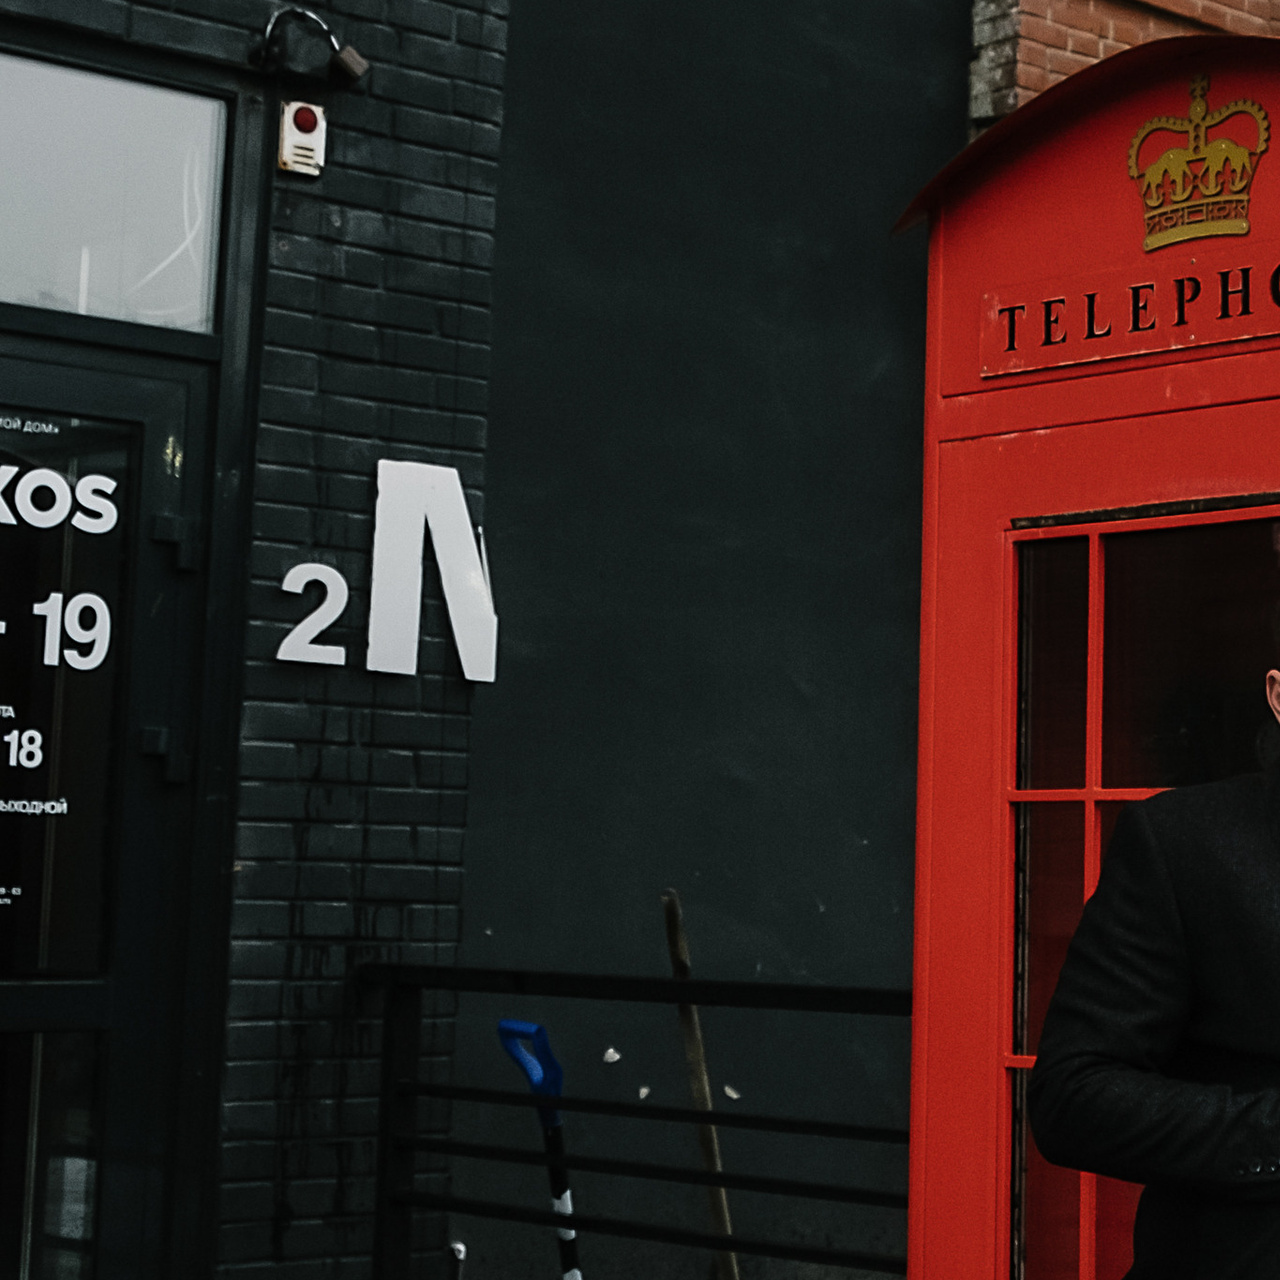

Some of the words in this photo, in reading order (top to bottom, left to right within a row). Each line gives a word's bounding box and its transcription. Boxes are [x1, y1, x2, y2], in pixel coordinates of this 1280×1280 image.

[33, 592, 111, 671] 19
[276, 563, 349, 666] 2
[3, 728, 44, 769] 18
